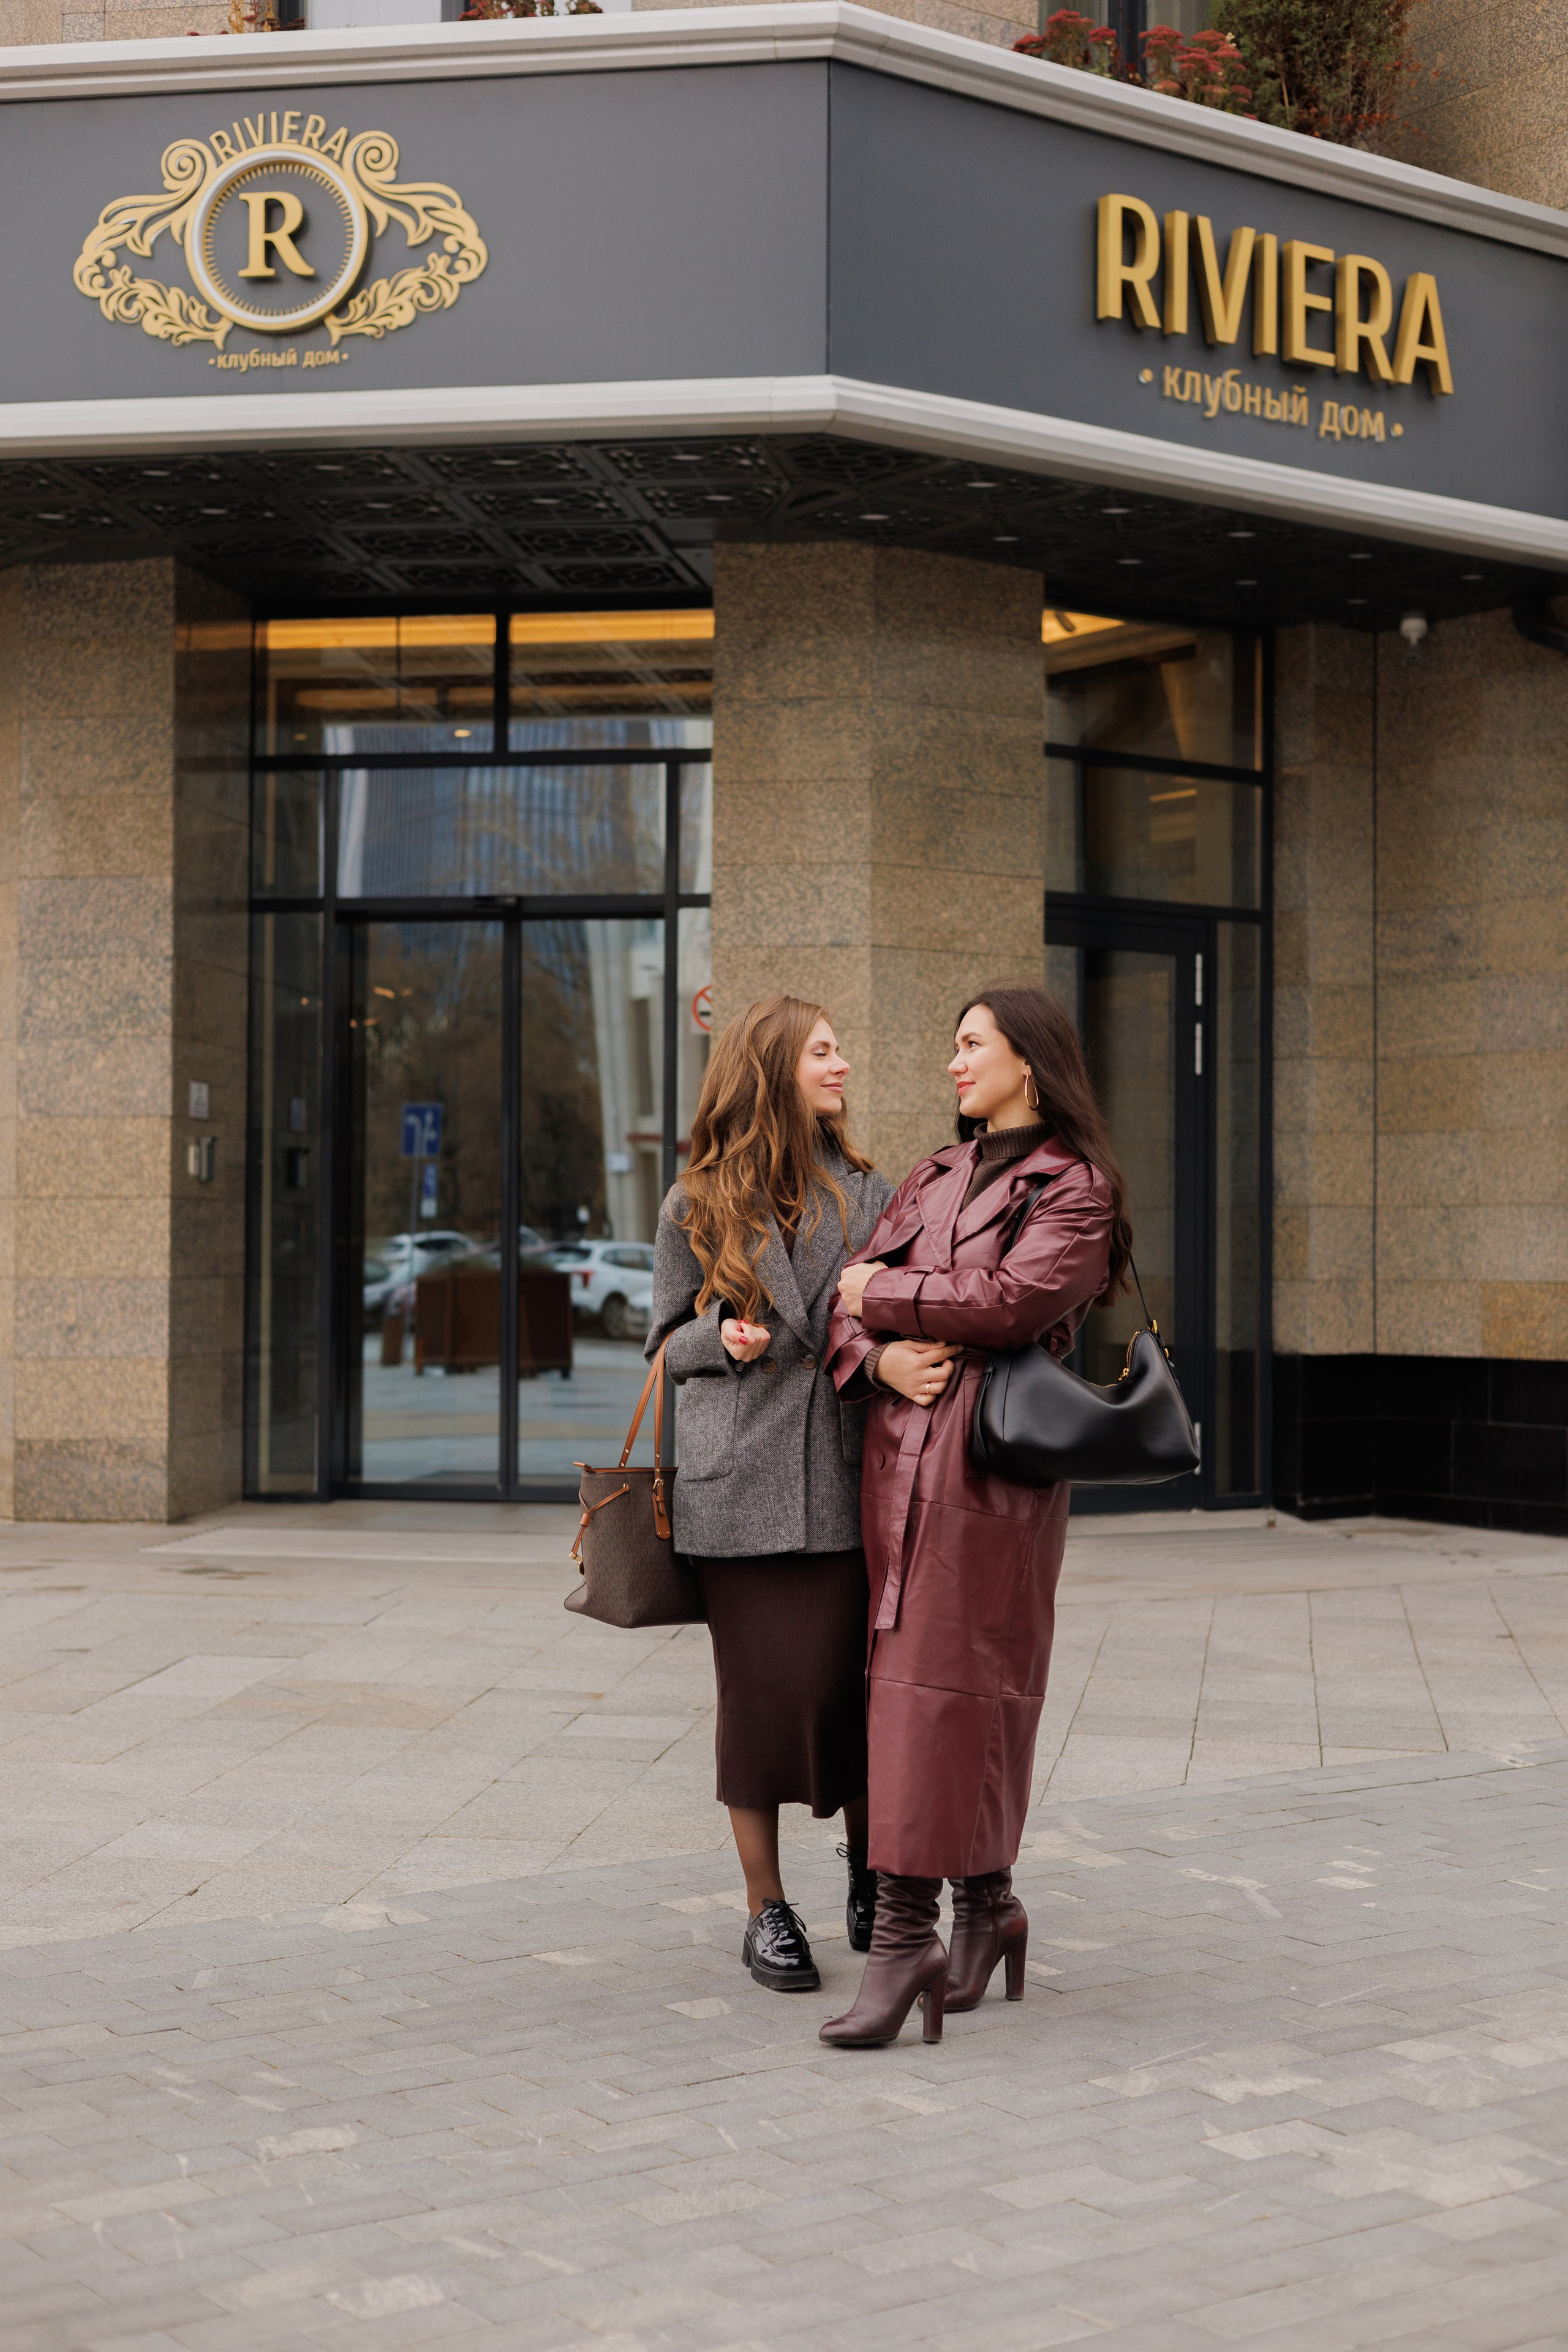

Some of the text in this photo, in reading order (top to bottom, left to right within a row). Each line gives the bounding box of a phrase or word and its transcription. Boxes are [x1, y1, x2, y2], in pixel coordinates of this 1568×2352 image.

[208, 110, 349, 164] RIVIERA
[238, 190, 315, 278] R
[1096, 193, 1455, 398] RIVIERA
